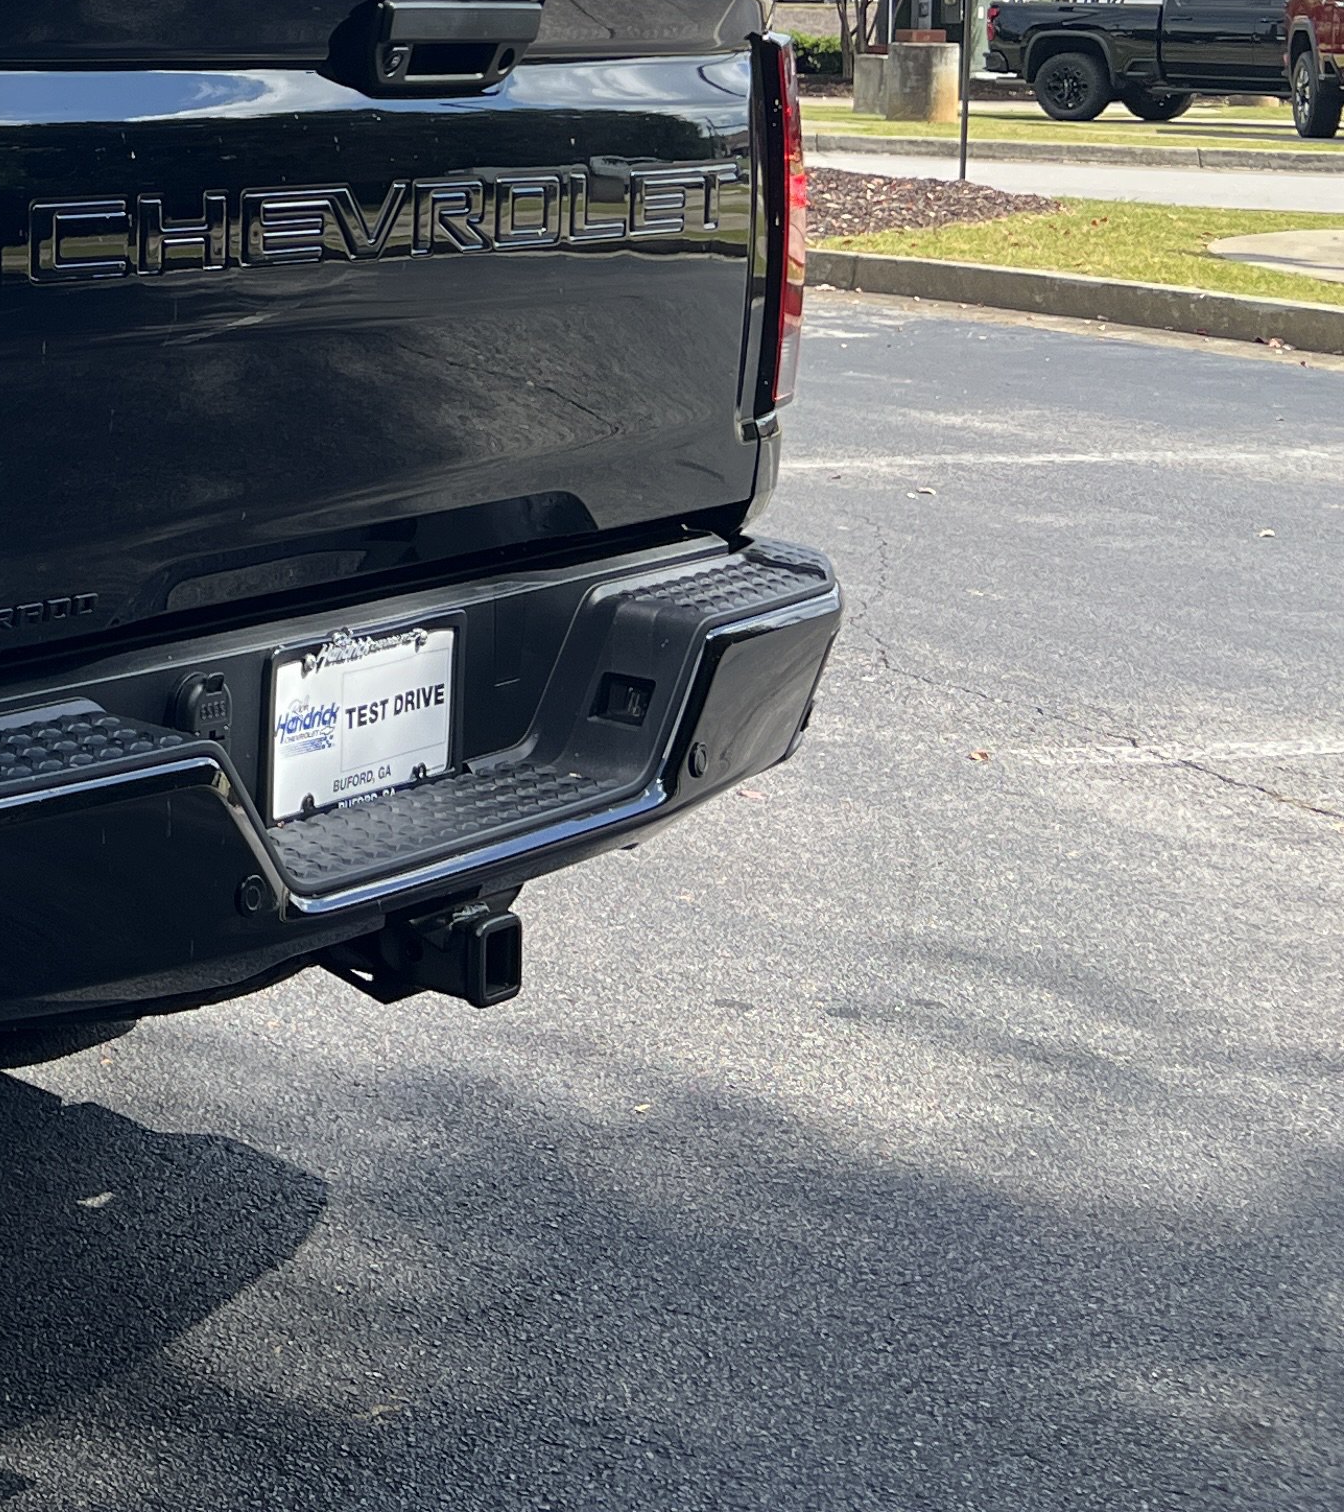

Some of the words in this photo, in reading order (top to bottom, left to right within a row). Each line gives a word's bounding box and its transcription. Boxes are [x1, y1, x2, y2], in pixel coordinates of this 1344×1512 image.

[28, 163, 738, 284] CHEVROLET
[275, 702, 341, 744] Hendrick
[345, 699, 389, 729] TEST
[394, 683, 445, 714] DRIVE
[333, 770, 375, 792] BUFORD,
[378, 764, 392, 780] GA
